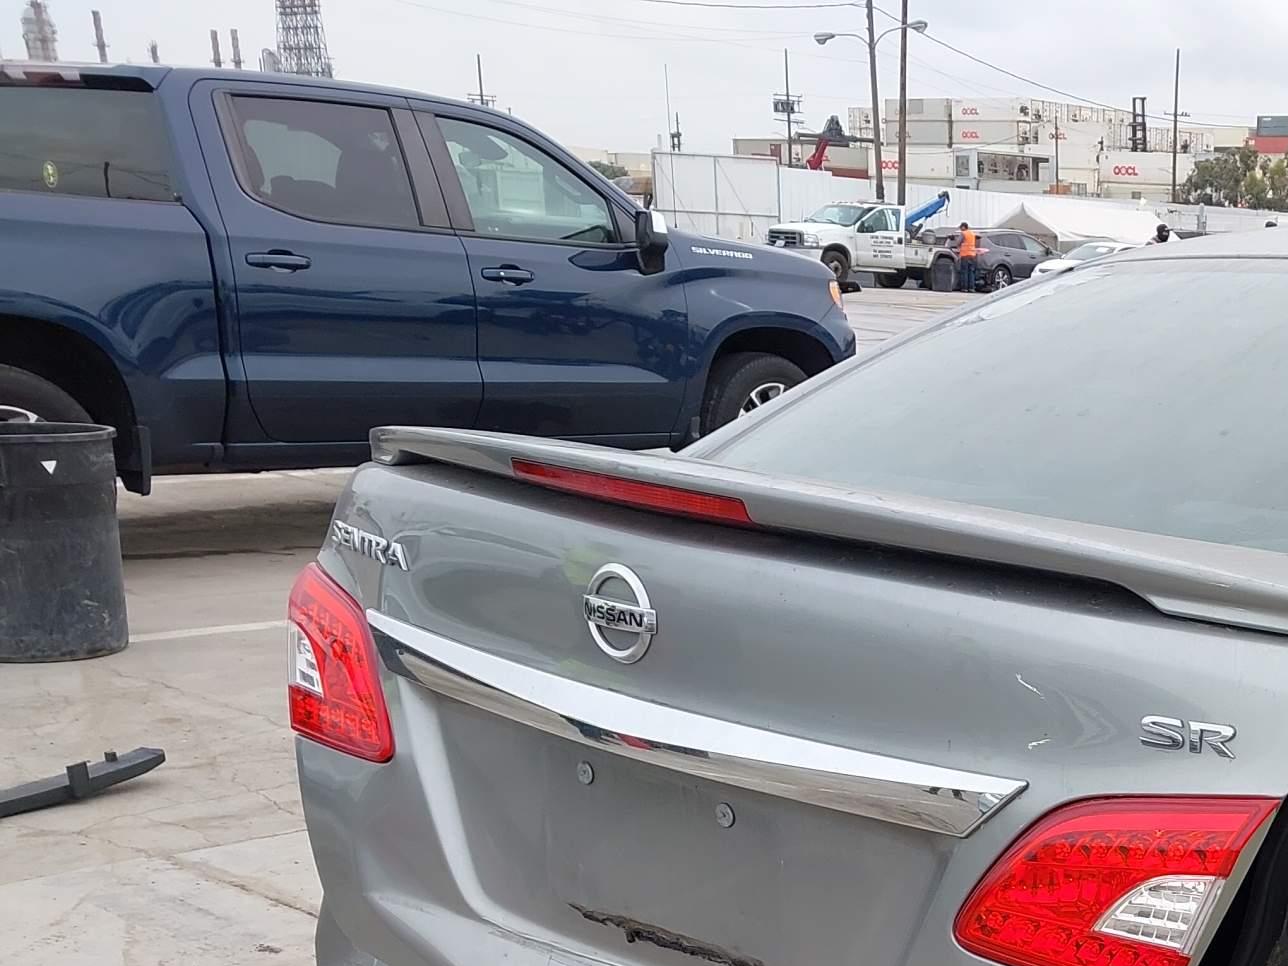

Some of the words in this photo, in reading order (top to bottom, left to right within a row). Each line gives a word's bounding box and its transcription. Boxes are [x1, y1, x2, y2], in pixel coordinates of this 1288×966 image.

[1112, 165, 1139, 176] OOCL
[691, 245, 753, 260] SILVERADO
[332, 519, 410, 572] SENTRA
[584, 598, 644, 628] NISSAN
[1138, 713, 1238, 760] SR
